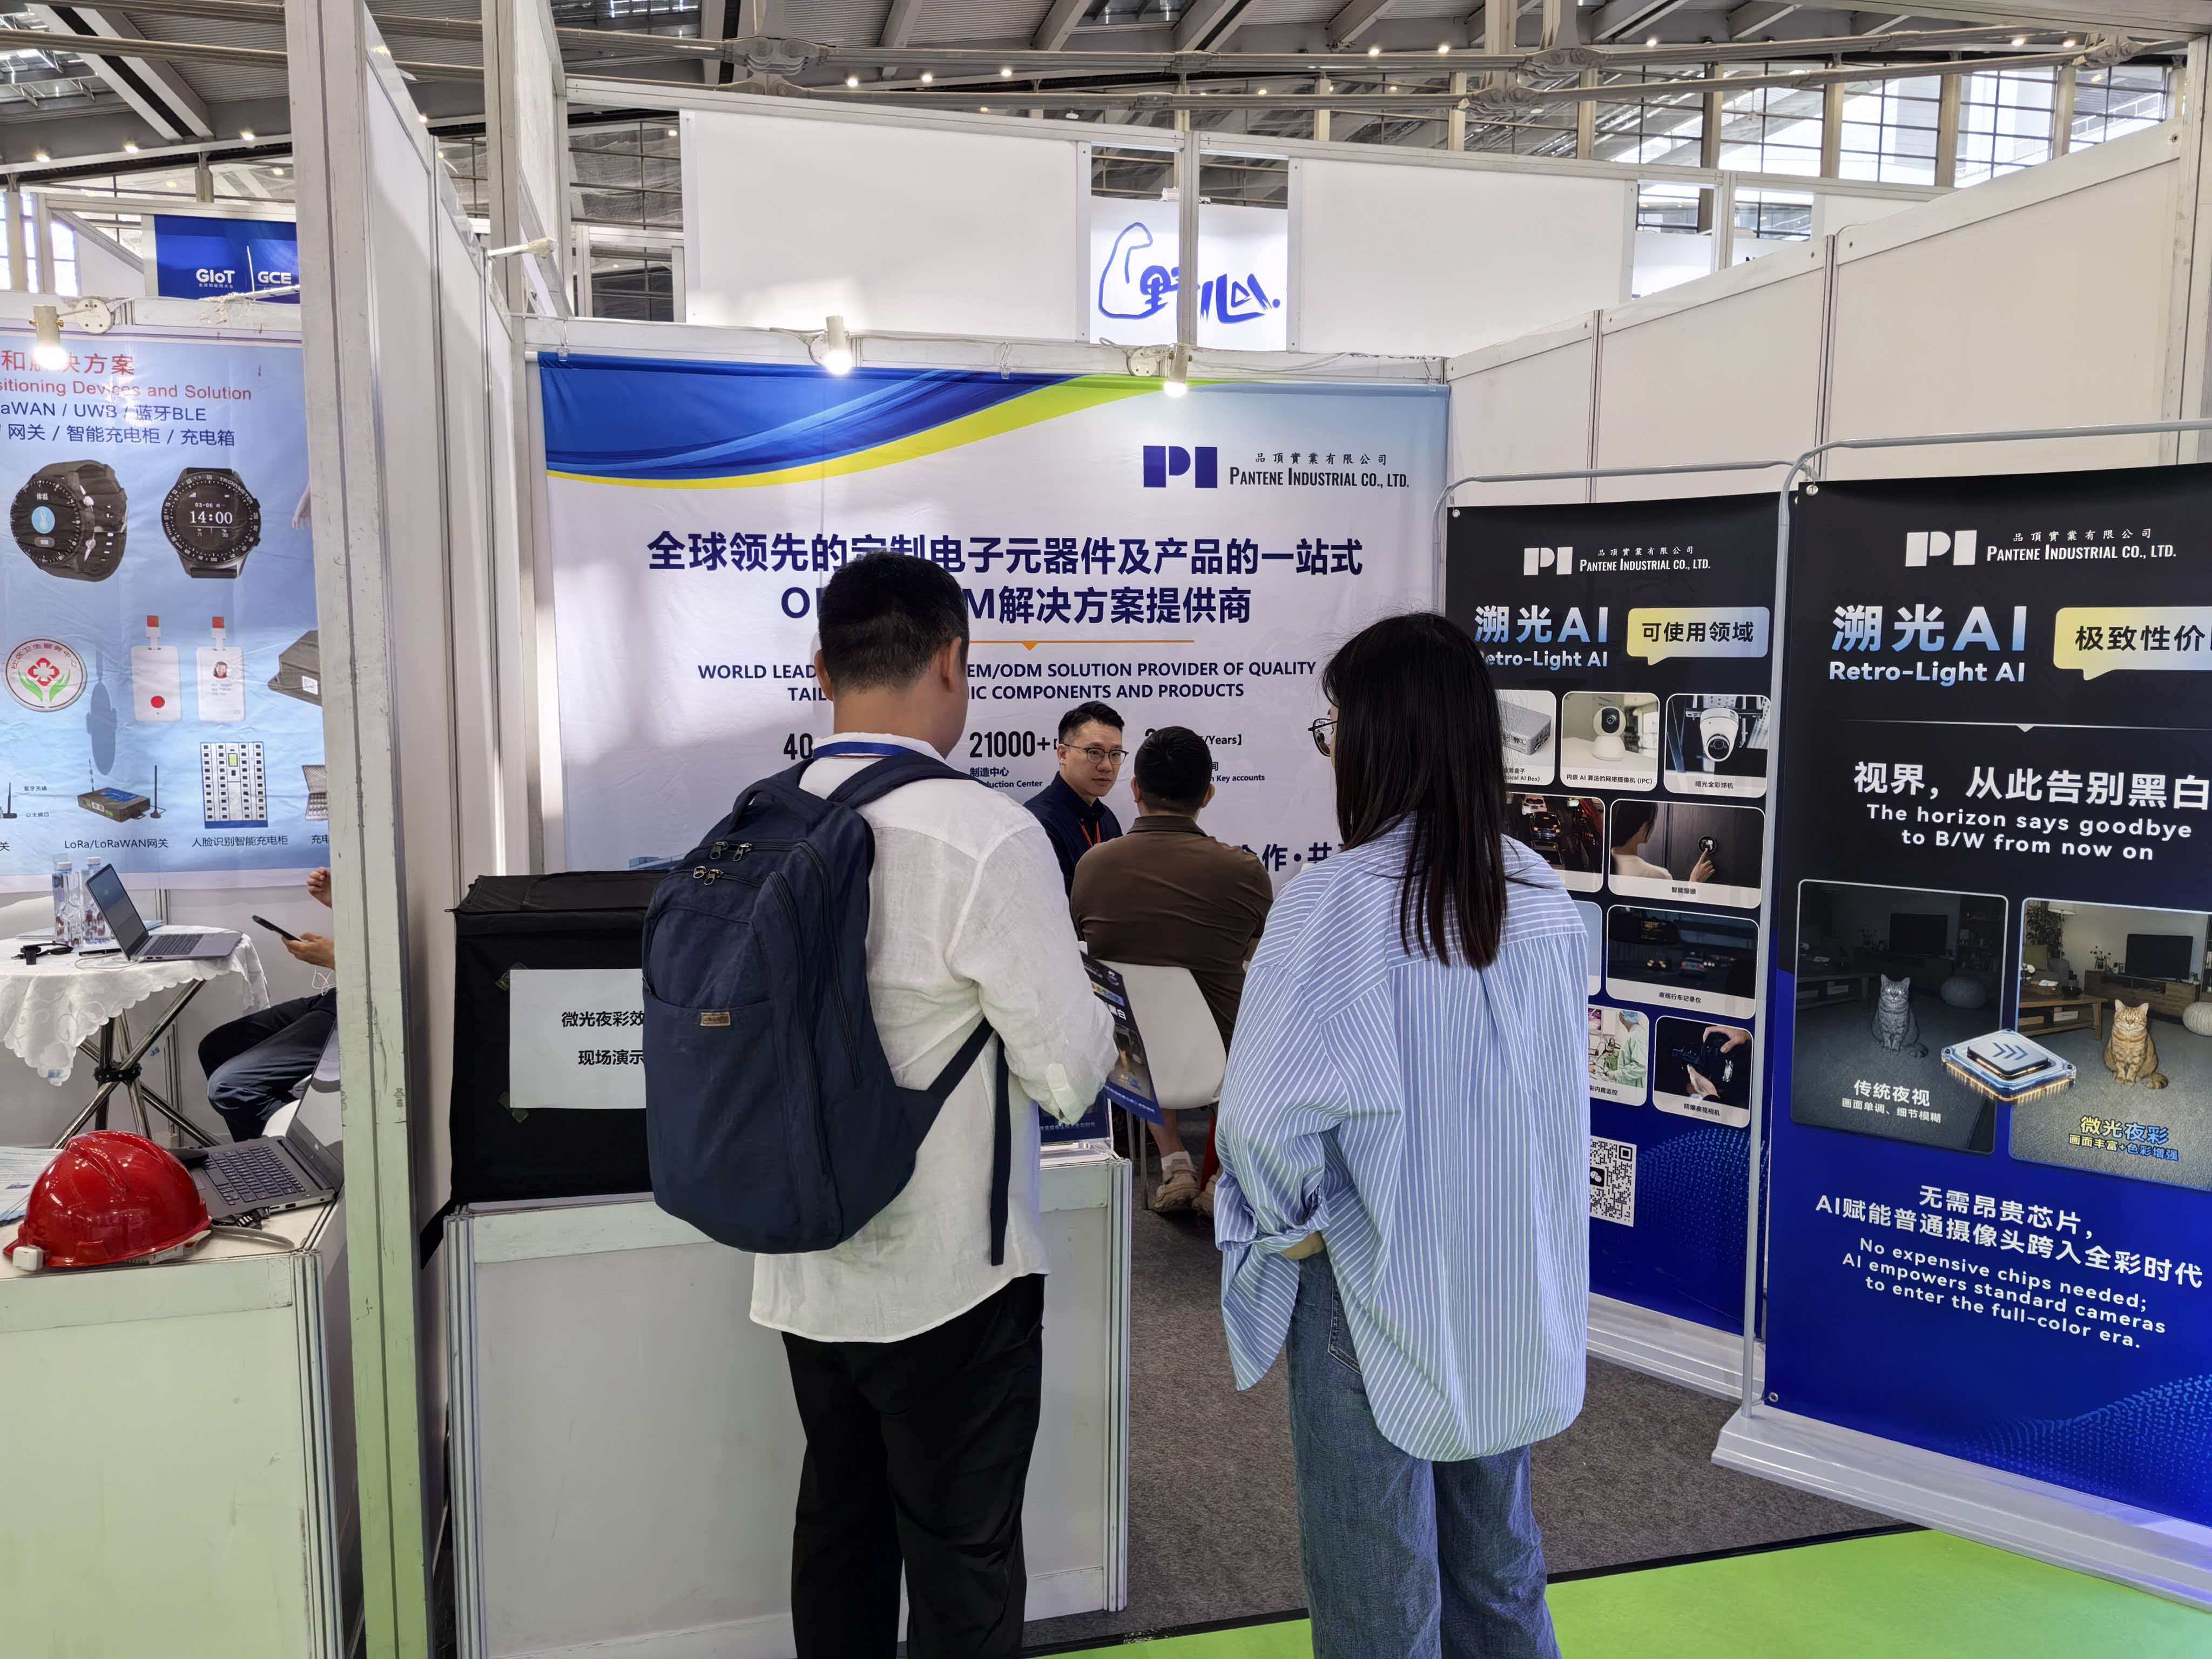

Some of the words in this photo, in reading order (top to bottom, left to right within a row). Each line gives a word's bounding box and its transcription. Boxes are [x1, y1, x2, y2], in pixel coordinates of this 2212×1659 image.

[196, 268, 235, 284] GIoT
[258, 271, 292, 285] GCE
[2, 350, 134, 375] 和决方案
[147, 385, 178, 397] and
[185, 385, 252, 400] Solution
[75, 404, 117, 418] UWB
[135, 404, 206, 421] 蓝牙BLE
[8, 423, 45, 441] 网关
[66, 425, 160, 444] 智能充电柜
[180, 429, 235, 447] 充电箱
[1255, 452, 1388, 465] 品頂實業有限公司
[1230, 467, 1284, 485] PANTENE
[1288, 467, 1358, 487] INDUSTRIAL
[1387, 473, 1410, 488] LTD.
[190, 510, 233, 524] 14:00
[2013, 528, 2152, 542] 品頂實業有限公司
[1597, 545, 1694, 557] 品頂實業有限公司
[1986, 545, 2040, 562] PANTENE
[2045, 544, 2118, 561] INDUSTRIAL
[2150, 544, 2177, 558] LTD.
[1580, 559, 1617, 572] PANTENE
[1620, 558, 1671, 571] INDUSTRIAL
[1693, 558, 1711, 570] LTD.
[1474, 605, 1608, 644] 溯光AI
[1642, 621, 1754, 643] 可使用领域
[1832, 604, 2027, 652] 溯光AI
[2075, 624, 2212, 652] 极致性价
[1587, 651, 1608, 667] AI
[698, 664, 767, 679] WORLD
[773, 664, 817, 679] LEAD
[967, 663, 1042, 679] EM/ODM
[1048, 663, 1132, 677] SOLUTION
[1137, 662, 1219, 676] PROVIDER
[1223, 662, 1244, 676] OF
[1249, 661, 1317, 677] QUALITY
[1829, 660, 1988, 687] Retro-Light
[1995, 662, 2025, 683] AI
[787, 687, 827, 701] TAIL
[992, 684, 1111, 700] COMPONENTS
[1116, 684, 1154, 698] AND
[1158, 683, 1244, 698] PRODUCTS
[969, 731, 1050, 758] 21000+
[970, 766, 1009, 778] 制造中心
[1217, 775, 1231, 784] Key
[1016, 780, 1043, 788] Center
[1867, 804, 1908, 821] The
[1917, 806, 2006, 827] horizon
[2016, 815, 2069, 834] says
[2079, 818, 2193, 841] goodbye
[0, 841, 10, 852] 关
[64, 838, 169, 849] LoRa/LoRaWAN网关
[192, 835, 289, 847] 人脸识别智能充电柜
[1901, 830, 1925, 845] to
[1936, 830, 1985, 849] B/W
[1994, 834, 2051, 854] from
[2061, 842, 2113, 858] now
[2122, 845, 2154, 860] on
[561, 1010, 644, 1028] 微光夜彩效
[578, 1049, 644, 1066] 现场演示
[1854, 1079, 1931, 1107] 传统夜视
[2079, 1114, 2169, 1145] 微光夜彩
[2069, 1133, 2180, 1162] 画面丰富+色彩增强
[1815, 1194, 2203, 1289] AI赋能普通摄像头跨入全彩时代
[1860, 1237, 1885, 1256] No
[1892, 1246, 1990, 1278] expensive
[1997, 1267, 2052, 1292] chips
[2060, 1283, 2147, 1312] needed;
[1842, 1253, 1862, 1268] AI
[1869, 1260, 1967, 1291] empowers
[1974, 1282, 2067, 1313] standard
[2075, 1305, 2167, 1334] cameras
[1865, 1276, 1885, 1291] to
[1892, 1283, 1945, 1305] enter
[1951, 1295, 1985, 1314] the
[1991, 1302, 2092, 1337] full-color
[2099, 1331, 2141, 1348] era.
